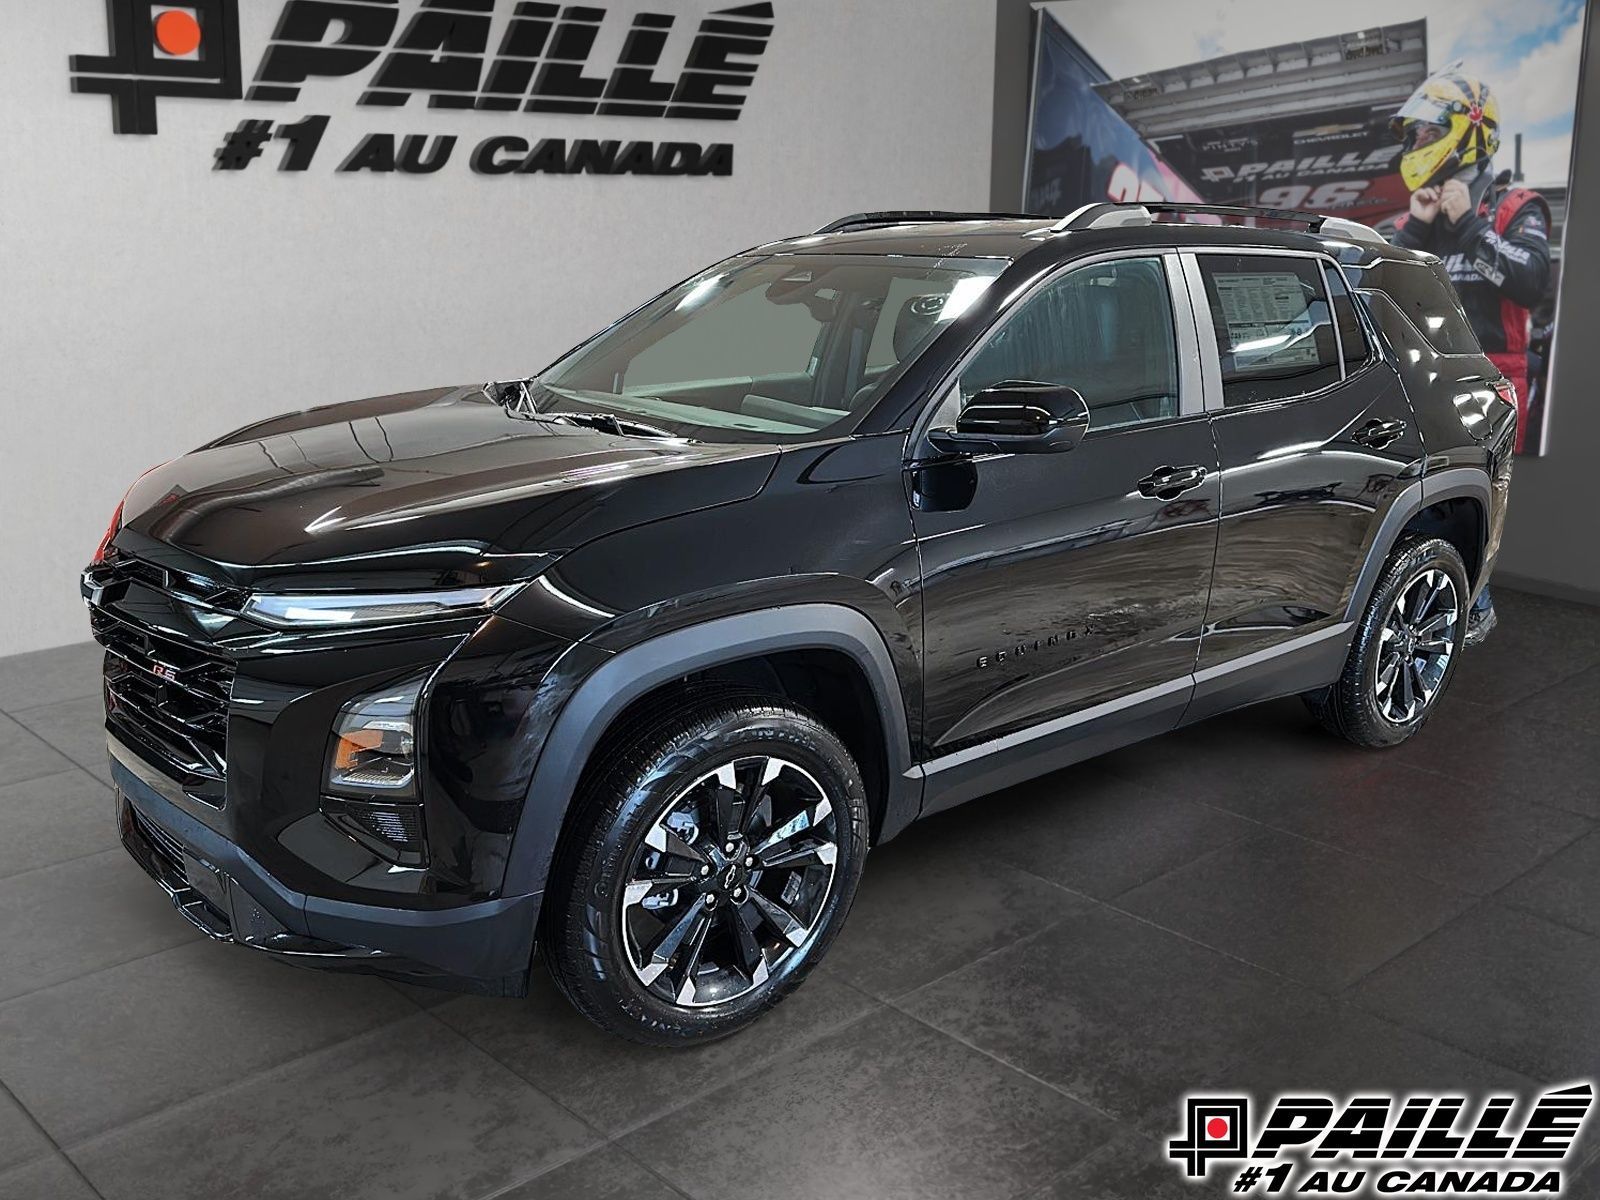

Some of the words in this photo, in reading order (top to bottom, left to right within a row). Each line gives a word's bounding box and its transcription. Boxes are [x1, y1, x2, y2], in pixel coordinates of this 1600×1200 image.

[212, 115, 331, 172] #1
[335, 133, 458, 174] AU
[468, 135, 734, 177] CANADA
[1293, 131, 1370, 145] CHEVROLET
[1293, 163, 1389, 177] CANADA
[1258, 180, 1371, 210] 96
[976, 623, 1095, 669] EQUINOX
[153, 664, 176, 681] RS
